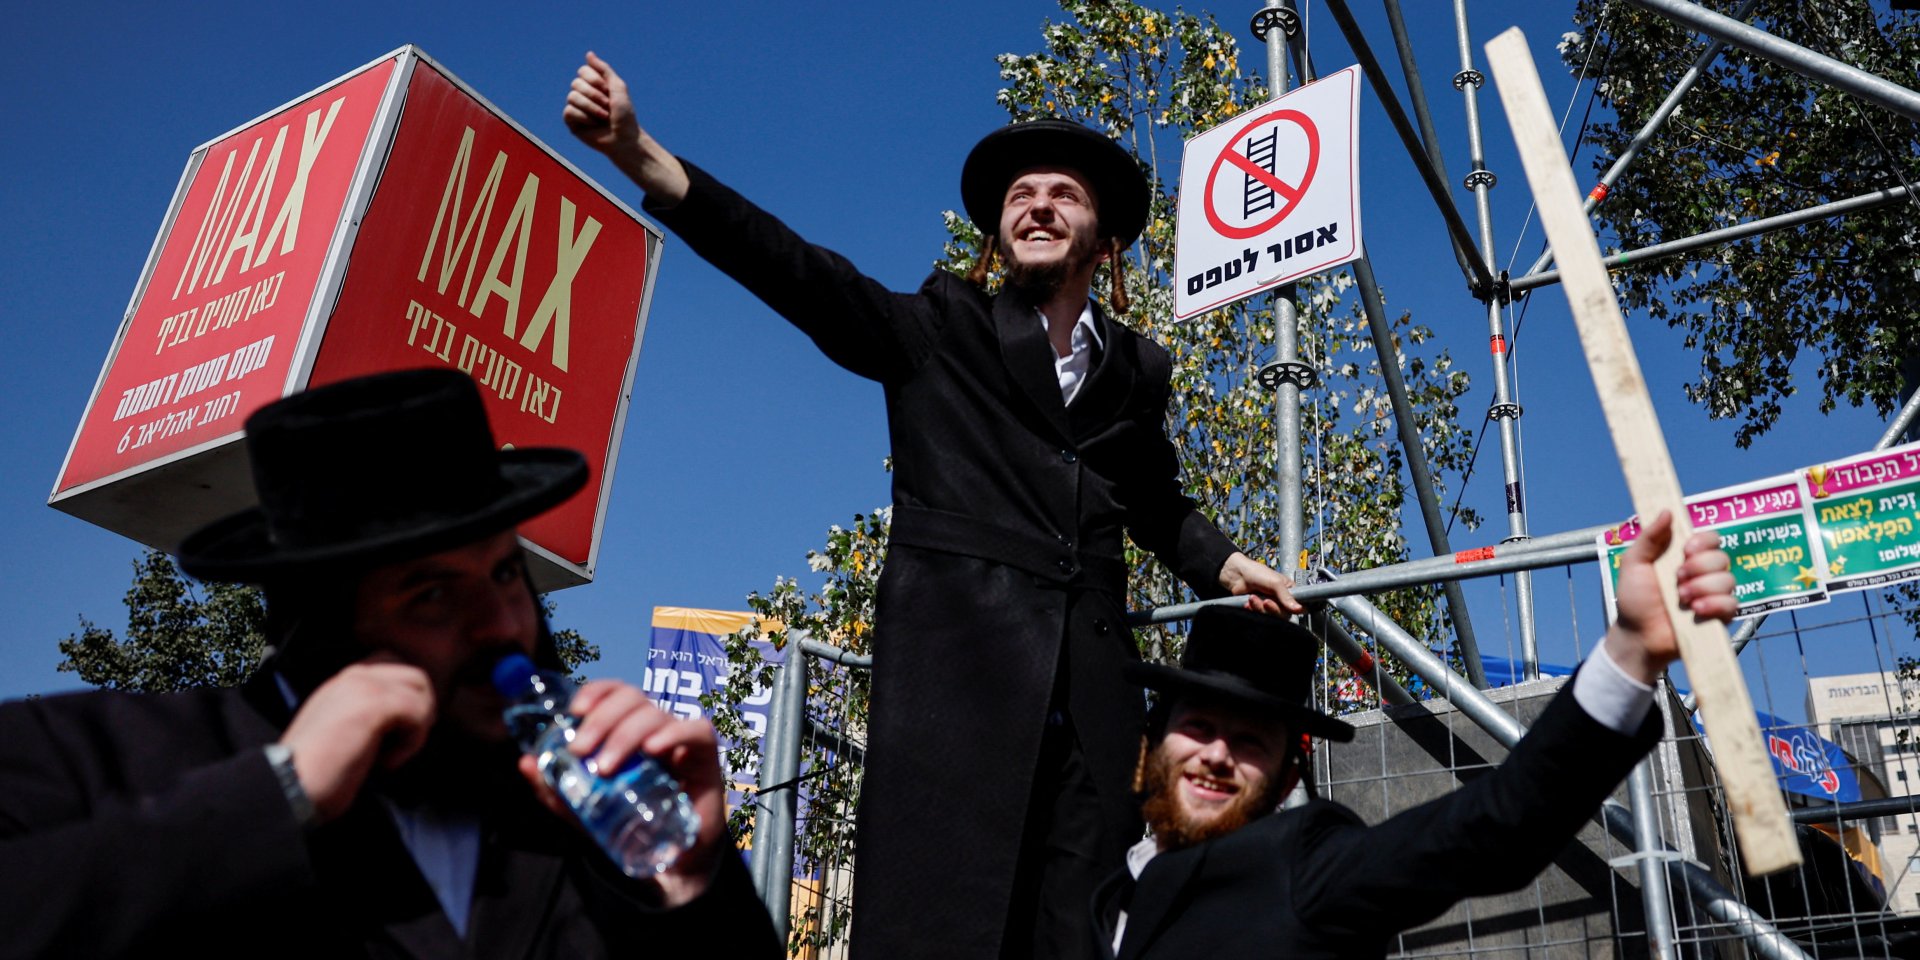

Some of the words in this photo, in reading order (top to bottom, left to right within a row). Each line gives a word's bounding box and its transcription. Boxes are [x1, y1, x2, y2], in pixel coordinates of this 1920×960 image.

[172, 96, 345, 300] MAX
[417, 125, 603, 373] MAX
[1267, 222, 1337, 263] אסור
[1188, 248, 1259, 295] לטפס
[194, 286, 251, 338] קונים
[244, 271, 285, 321] כאן
[154, 308, 198, 355] בכיף
[406, 299, 456, 363] בכיף
[173, 353, 230, 404] סטוק
[226, 335, 275, 381] מקס
[457, 334, 522, 400] קונים
[113, 373, 179, 422] רוממה
[197, 391, 241, 427] רחוב
[520, 373, 562, 424] כאן
[116, 426, 133, 455] 6
[131, 406, 199, 449] אהליאב
[1904, 452, 1920, 472] ל
[648, 647, 667, 661] רק
[671, 650, 693, 662] הוא
[1828, 684, 1880, 698] הבריאות
